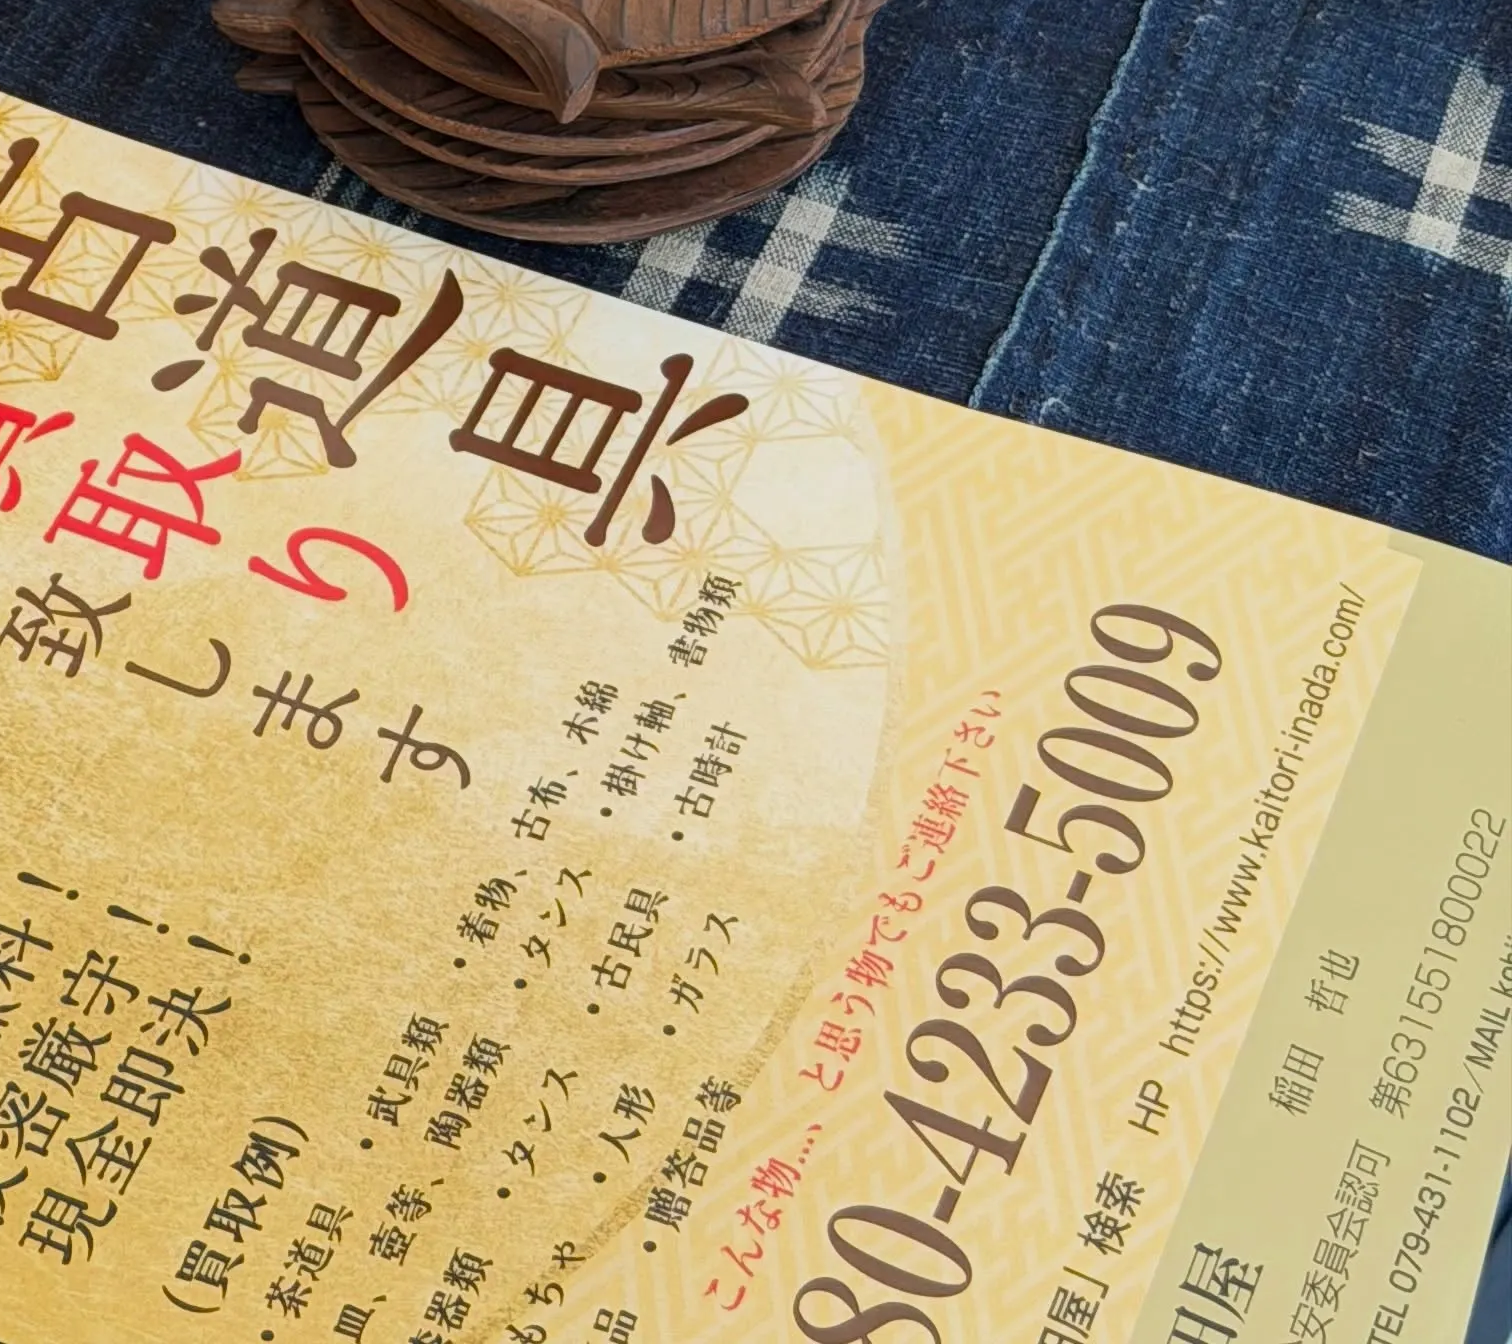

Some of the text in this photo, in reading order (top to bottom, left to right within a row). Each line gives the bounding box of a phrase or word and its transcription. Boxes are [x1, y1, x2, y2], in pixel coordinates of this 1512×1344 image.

[17, 934, 252, 1266] 現金即決！
[791, 602, 1223, 1344] 80-4233-5009
[1077, 1168, 1146, 1258] 検索
[1127, 1077, 1172, 1137] HP
[1158, 581, 1368, 1059] https://www.kaitori-inada.com/
[1278, 806, 1508, 1344] 安委員会認可 第631551800022
